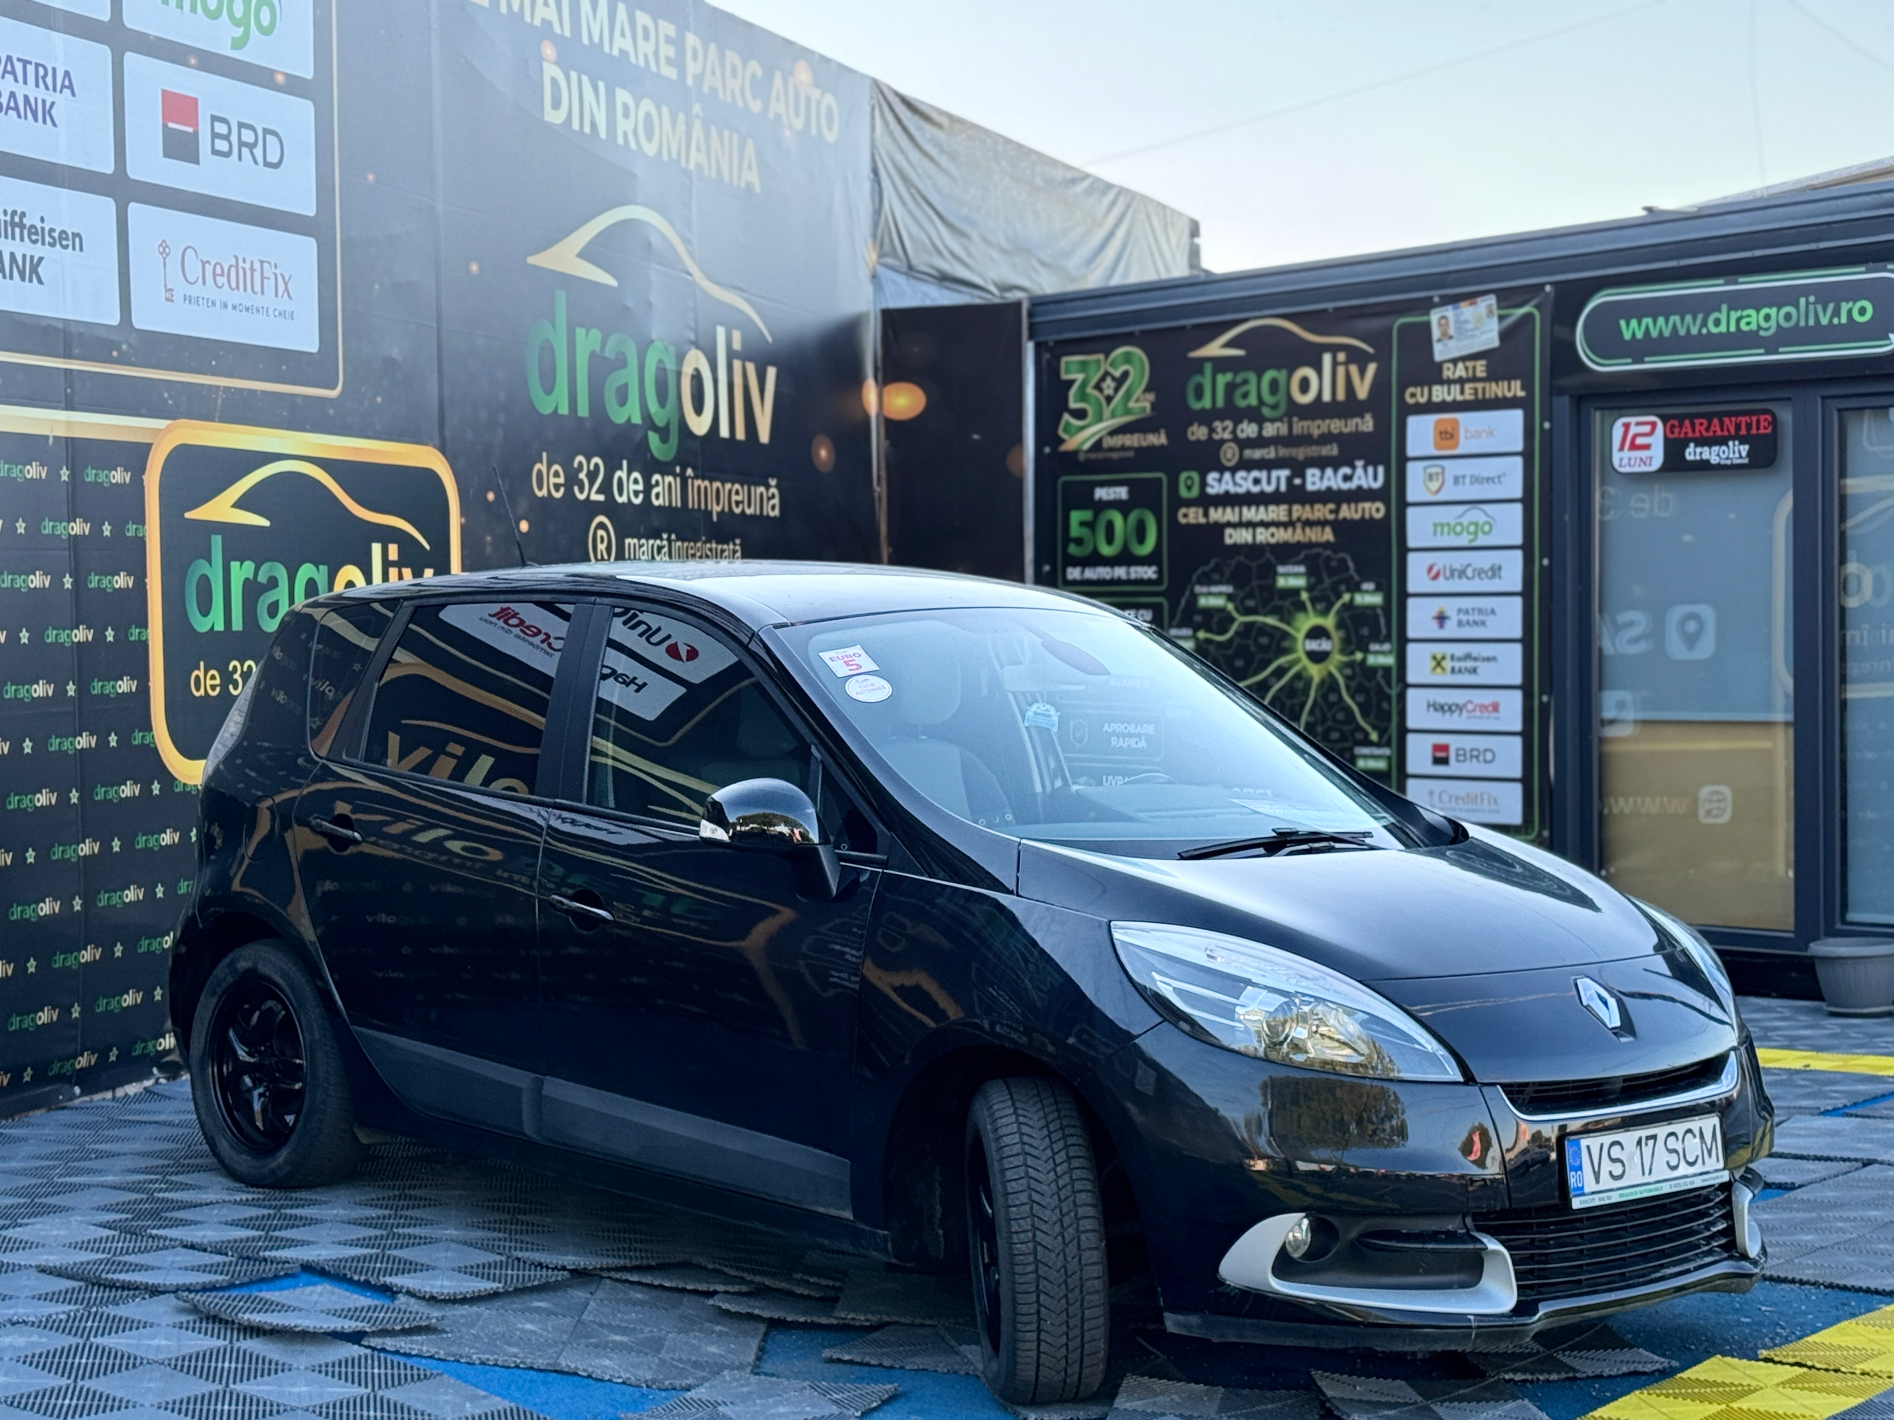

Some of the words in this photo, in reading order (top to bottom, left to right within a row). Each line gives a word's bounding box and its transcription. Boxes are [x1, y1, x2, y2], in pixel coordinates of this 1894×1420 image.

[0, 54, 77, 98] ATRIA
[581, 0, 678, 81] MARE
[684, 30, 763, 115] PARC
[767, 65, 841, 145] AUTO
[542, 60, 607, 140] DIN
[614, 86, 762, 194] ROMÂNIA
[209, 113, 285, 170] BRD
[0, 208, 84, 253] iffeisen
[180, 245, 294, 301] CreditFix
[183, 293, 217, 309] PRIETEN
[219, 299, 229, 310] IN
[231, 302, 271, 318] MOMENTE
[272, 308, 295, 321] CHEIE
[1618, 295, 1874, 341] www.dragoliv.ro
[525, 288, 778, 463] dragoliv
[1441, 360, 1488, 380] RATE
[1058, 346, 1150, 441] 32
[1185, 351, 1378, 419] dragoliv
[1404, 386, 1429, 405] CU
[1431, 379, 1526, 403] BULETINUL
[1187, 422, 1208, 442] de
[1211, 419, 1234, 440] 32
[1236, 418, 1259, 438] de
[1261, 416, 1288, 437] ani
[1292, 413, 1374, 440] împreună
[1464, 426, 1496, 441] bank
[1617, 420, 1658, 453] 12
[1664, 413, 1773, 440] GARANTIE
[1617, 456, 1654, 469] LUNI
[1684, 440, 1750, 465] dragoliv
[83, 465, 131, 487] dragoliv
[531, 451, 565, 500] de
[573, 454, 605, 502] 32
[612, 459, 644, 506] de
[650, 465, 682, 508] ani
[686, 467, 781, 522] împreună
[1205, 468, 1291, 495] SASCUT
[1304, 460, 1385, 492] BACĂU
[1452, 474, 1468, 487] BT
[1094, 486, 1129, 500] PESTE
[1177, 506, 1207, 525] CEL
[1208, 504, 1240, 524] MAI
[1241, 503, 1290, 524] MARE
[1291, 502, 1336, 523] PARC
[1337, 500, 1386, 521] AUTO
[40, 517, 91, 540] dragoliv
[1066, 508, 1158, 557] 500
[1223, 526, 1253, 545] DIN
[1254, 523, 1335, 545] ROMÂNIA
[1432, 519, 1494, 544] mogo
[623, 532, 671, 562] marcă
[0, 570, 51, 593] dragoliv
[87, 571, 135, 593] dragoliv
[1066, 566, 1081, 580] DE
[1082, 566, 1112, 580] AUTO
[1129, 565, 1159, 580] STOC
[1442, 563, 1503, 582] UniCredit
[1456, 607, 1497, 618] PATRIA
[1457, 618, 1488, 629] BANK
[44, 624, 94, 647] dragoliv
[828, 652, 862, 663] EURO
[843, 659, 863, 672] 5
[1450, 664, 1480, 676] BANK
[3, 679, 55, 702] dragoliv
[89, 675, 138, 698] dragoliv
[189, 660, 221, 697] de
[1426, 699, 1501, 718] HappyCredit
[1102, 723, 1156, 735] APROBARE
[47, 731, 98, 755] dragoliv
[1454, 747, 1496, 764] BRD
[6, 788, 58, 813] dragoliv
[93, 780, 141, 803] dragoliv
[1438, 789, 1499, 808] CreditFix
[51, 838, 100, 863] dragoliv
[134, 828, 180, 851] dragoliv
[8, 897, 61, 922] dragoliv
[96, 884, 145, 908] dragoliv
[52, 944, 102, 970] dragoliv
[8, 1005, 60, 1031] dragoliv
[94, 988, 144, 1013] dragoliv
[48, 1050, 98, 1077] dragoliv
[1585, 1140, 1627, 1185] VS
[1635, 1133, 1659, 1177] 17
[1664, 1123, 1721, 1171] SCM
[1570, 1170, 1583, 1189] RO
